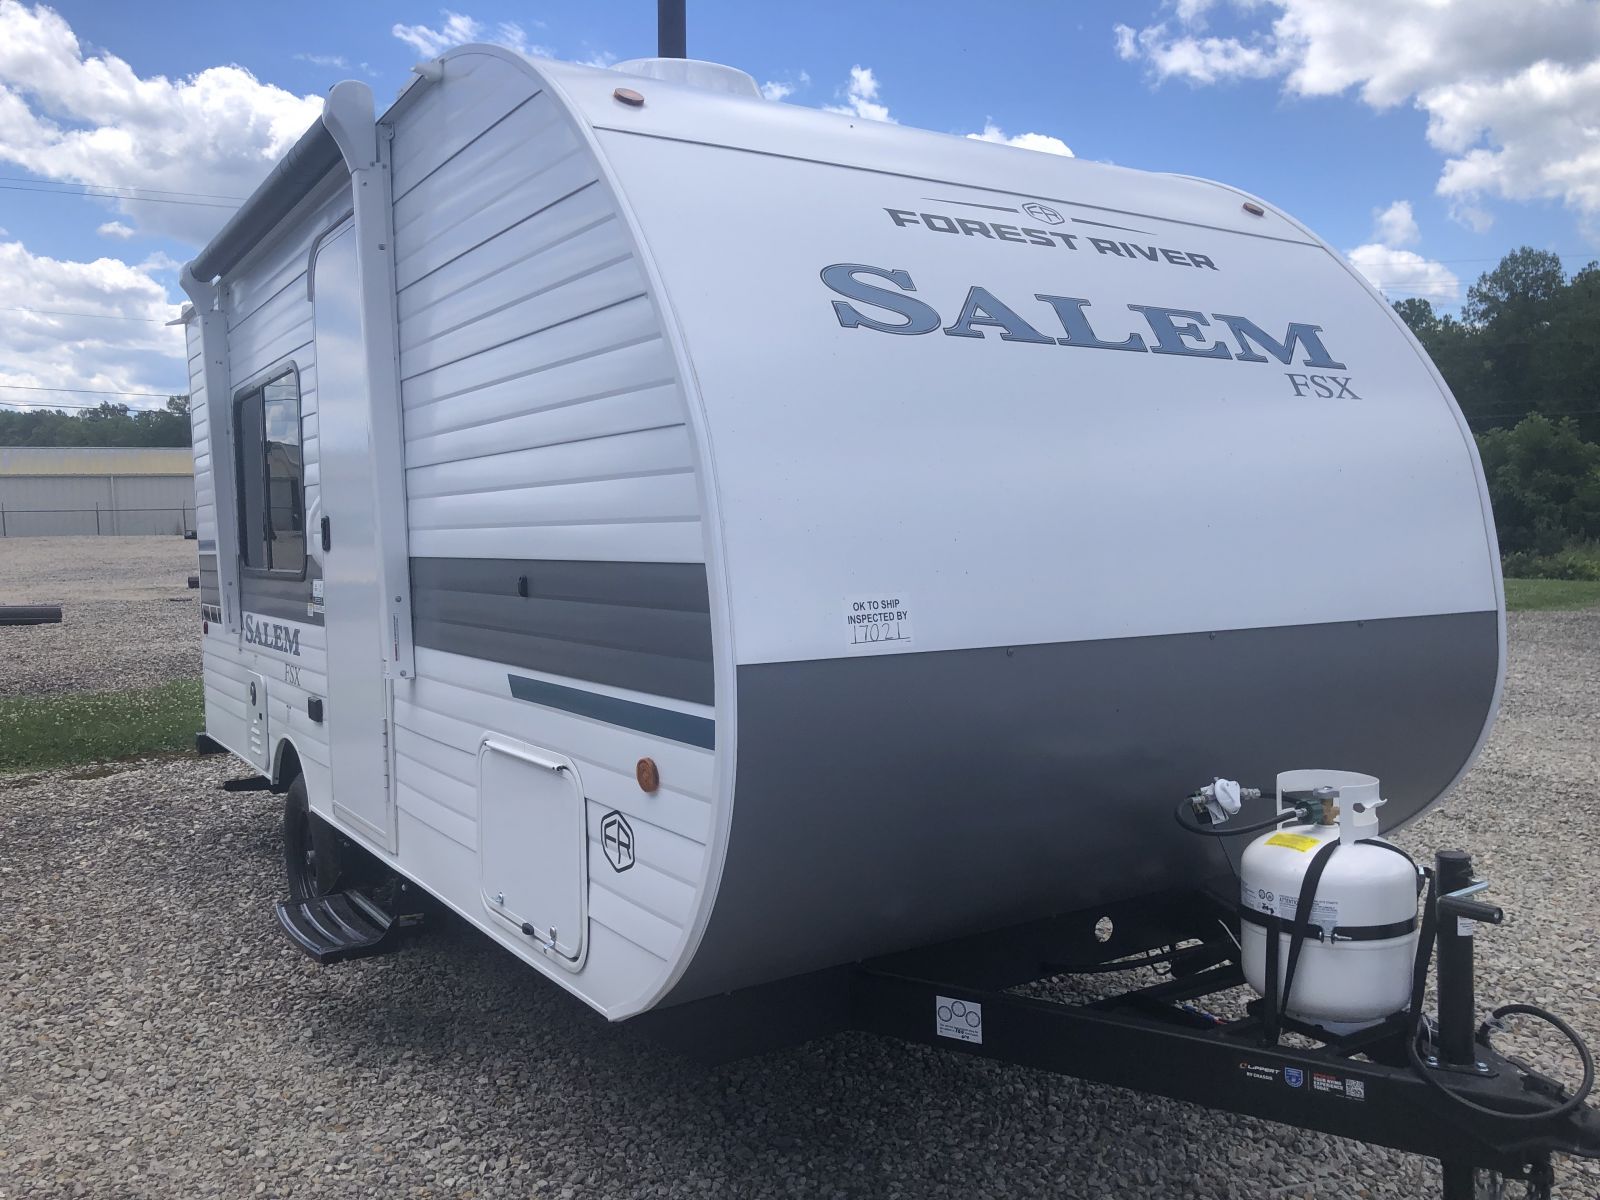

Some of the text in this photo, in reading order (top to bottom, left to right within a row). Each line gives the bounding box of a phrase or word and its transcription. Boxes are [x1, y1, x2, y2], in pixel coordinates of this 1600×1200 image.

[882, 207, 1220, 271] FOREST RIVER
[820, 263, 1346, 370] SALEM
[1284, 372, 1363, 400] FSX
[847, 611, 908, 625] INSPECTED BY
[852, 599, 900, 611] OK TO SHIP
[245, 613, 301, 656] SALEM
[284, 663, 301, 687] FSX
